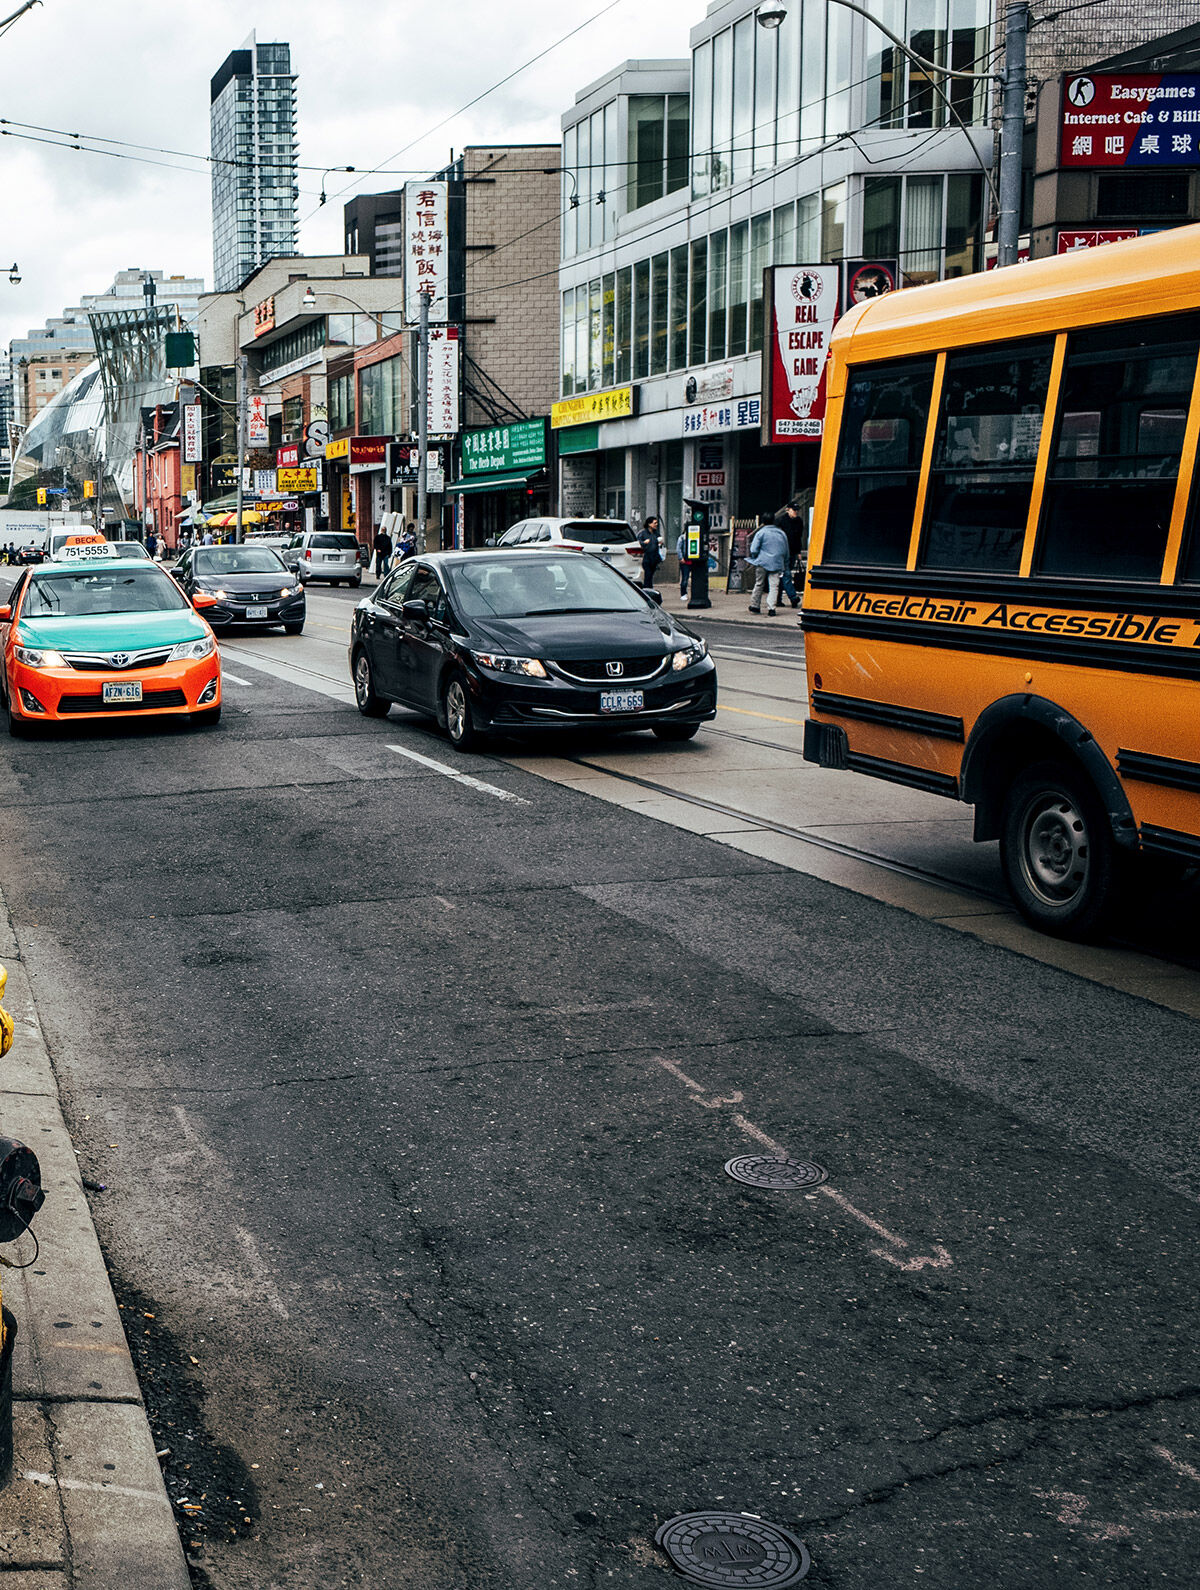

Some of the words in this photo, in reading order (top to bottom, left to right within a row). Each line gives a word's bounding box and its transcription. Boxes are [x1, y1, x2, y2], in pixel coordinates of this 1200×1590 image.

[1110, 85, 1196, 102] Easygames
[1064, 112, 1121, 125] Internet
[1124, 111, 1154, 124] Cafe
[1158, 110, 1170, 123] &
[1072, 134, 1192, 155] 網吧桌球
[795, 305, 818, 323] REAL
[788, 331, 824, 350] ESCAPE
[793, 358, 818, 375] GAME
[737, 400, 760, 426] 星島
[469, 458, 477, 470] The
[478, 456, 490, 468] Herb
[490, 454, 505, 470] Depot
[255, 503, 268, 511] SPA
[65, 546, 109, 557] 751-5555
[832, 590, 978, 623] Wheelchair
[982, 604, 1182, 644] Accessible
